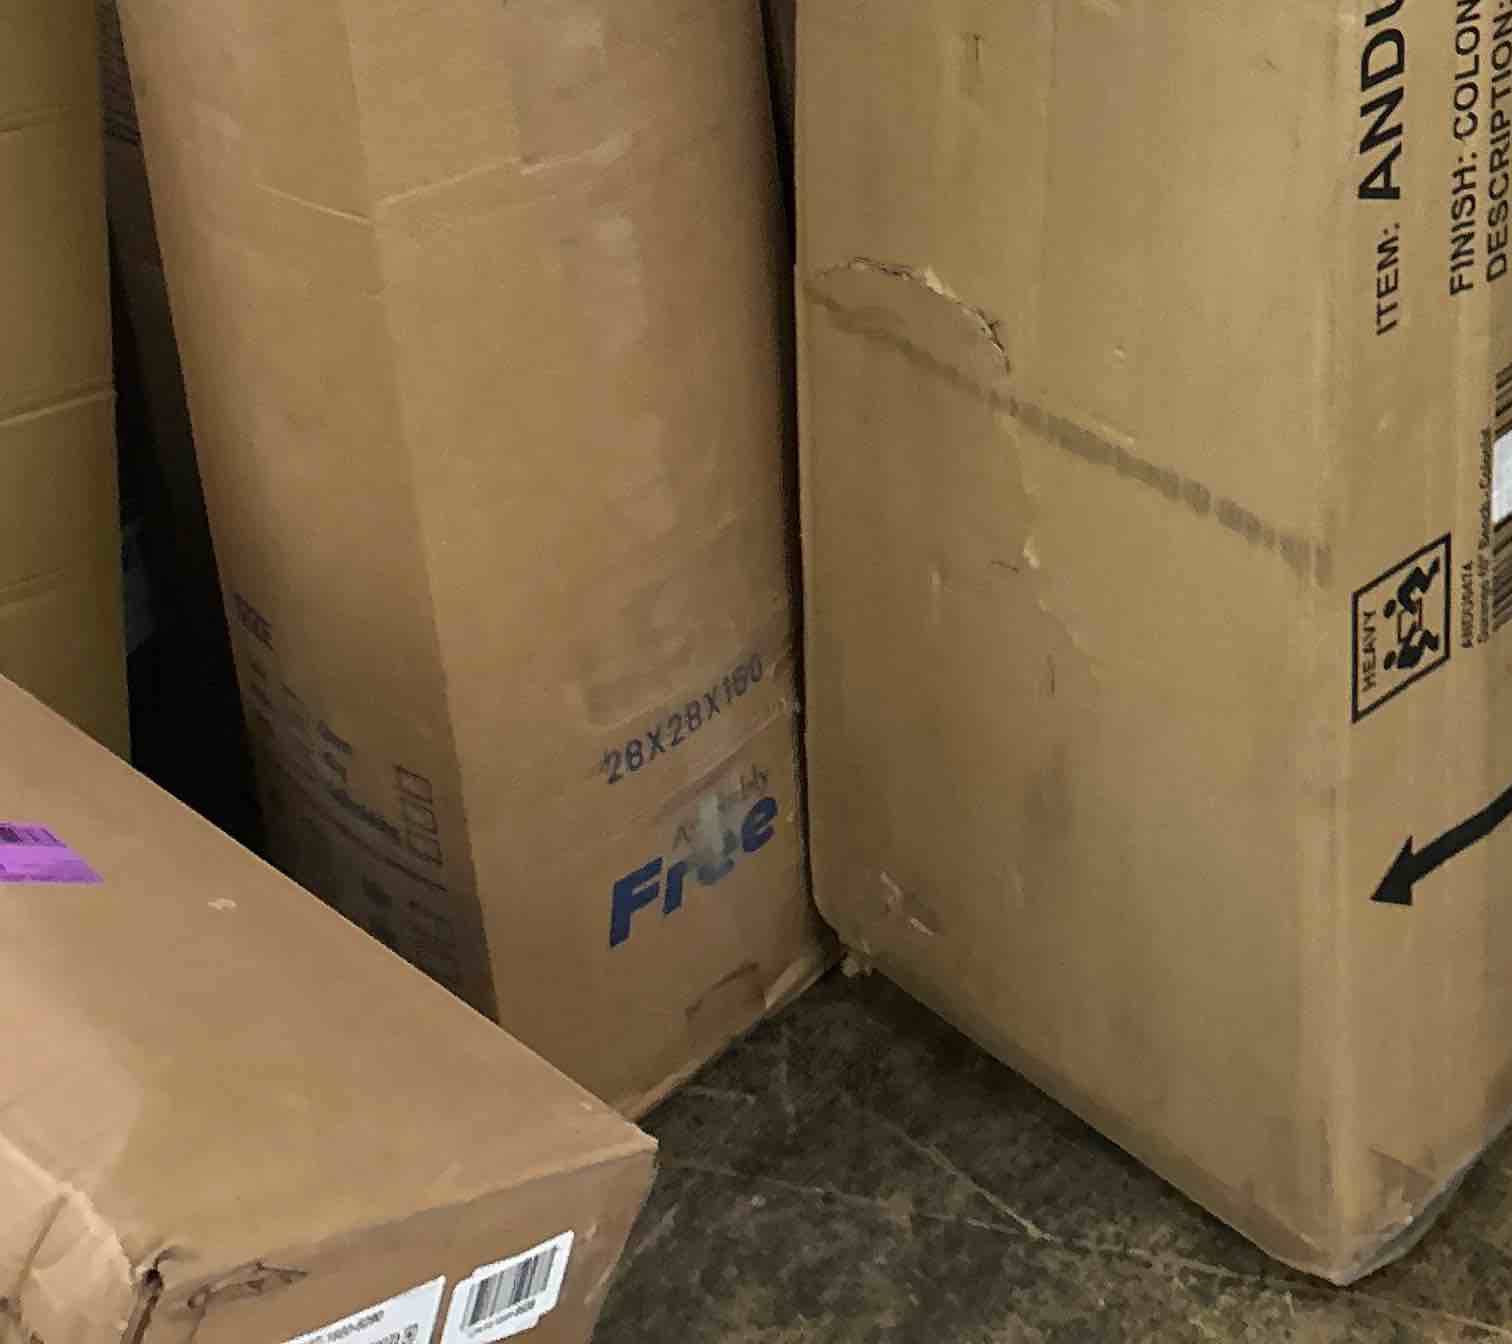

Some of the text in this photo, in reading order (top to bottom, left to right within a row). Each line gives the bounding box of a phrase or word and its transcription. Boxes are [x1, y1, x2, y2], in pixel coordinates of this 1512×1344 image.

[1450, 146, 1479, 295] FINISH:
[1376, 222, 1400, 336] ITEM:
[1361, 608, 1377, 693] HEAVY
